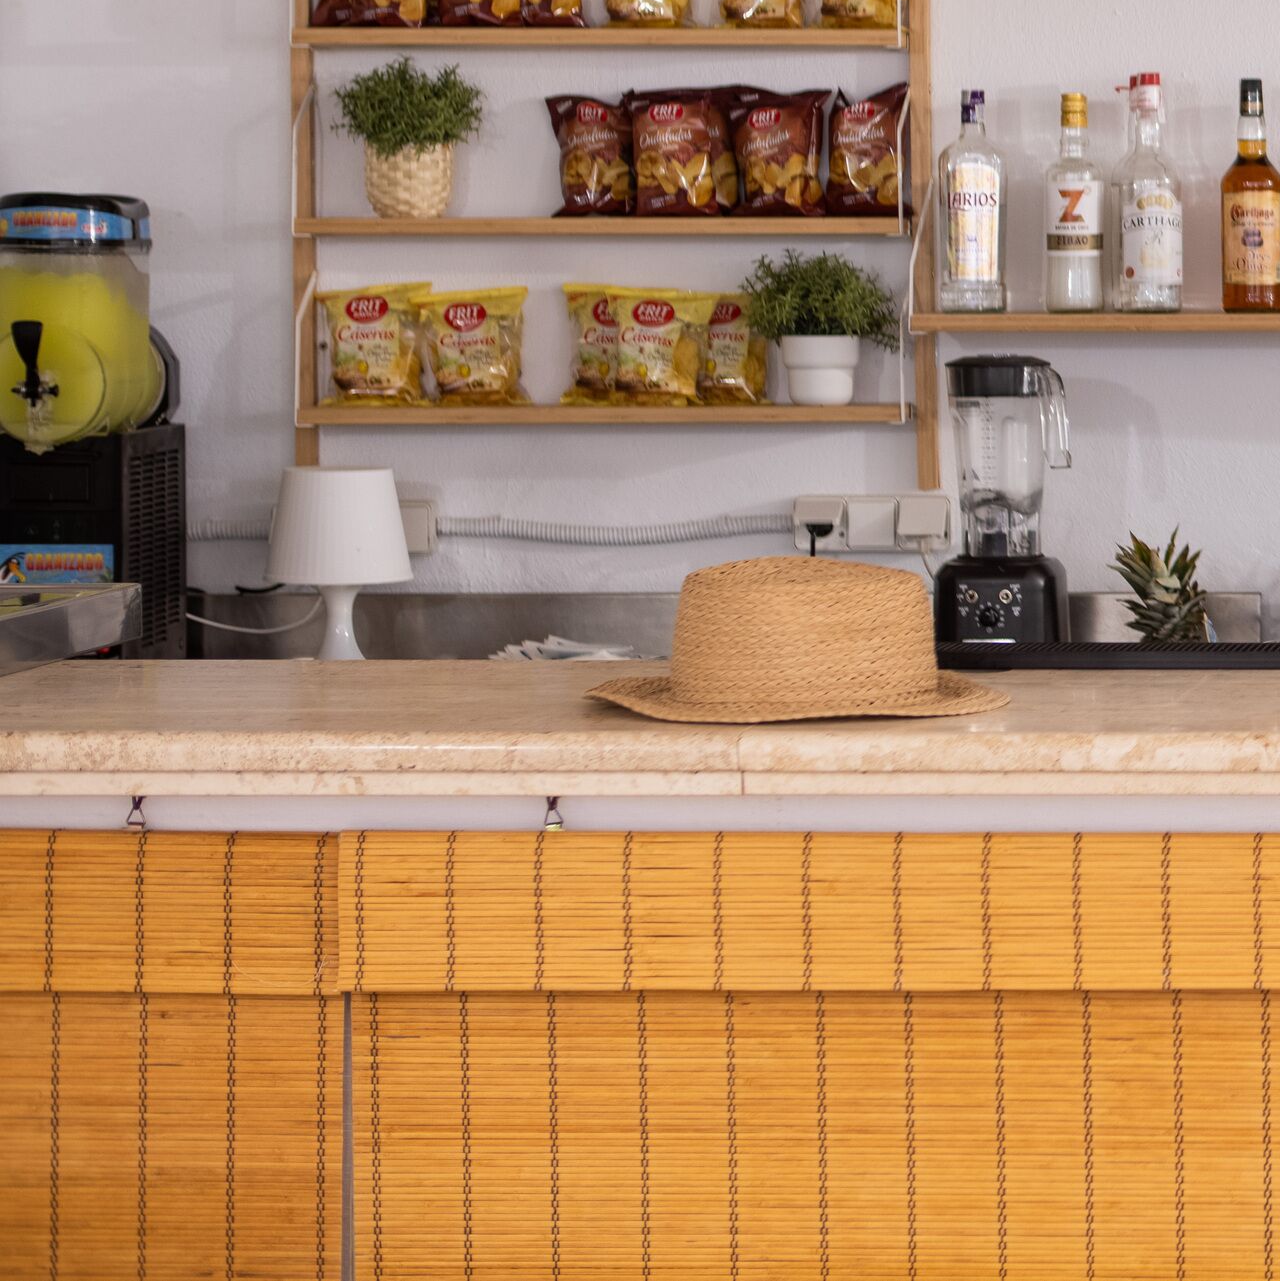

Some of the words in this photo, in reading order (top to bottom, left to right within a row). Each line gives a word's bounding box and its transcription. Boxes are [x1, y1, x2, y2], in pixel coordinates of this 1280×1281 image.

[653, 104, 680, 117] FRIT
[1058, 189, 1085, 223] Z
[350, 299, 383, 314] FRIT
[448, 306, 481, 321] FRIT
[637, 303, 671, 318] FRIT
[337, 325, 396, 342] Caseras
[26, 553, 104, 571] GRANIZADO
